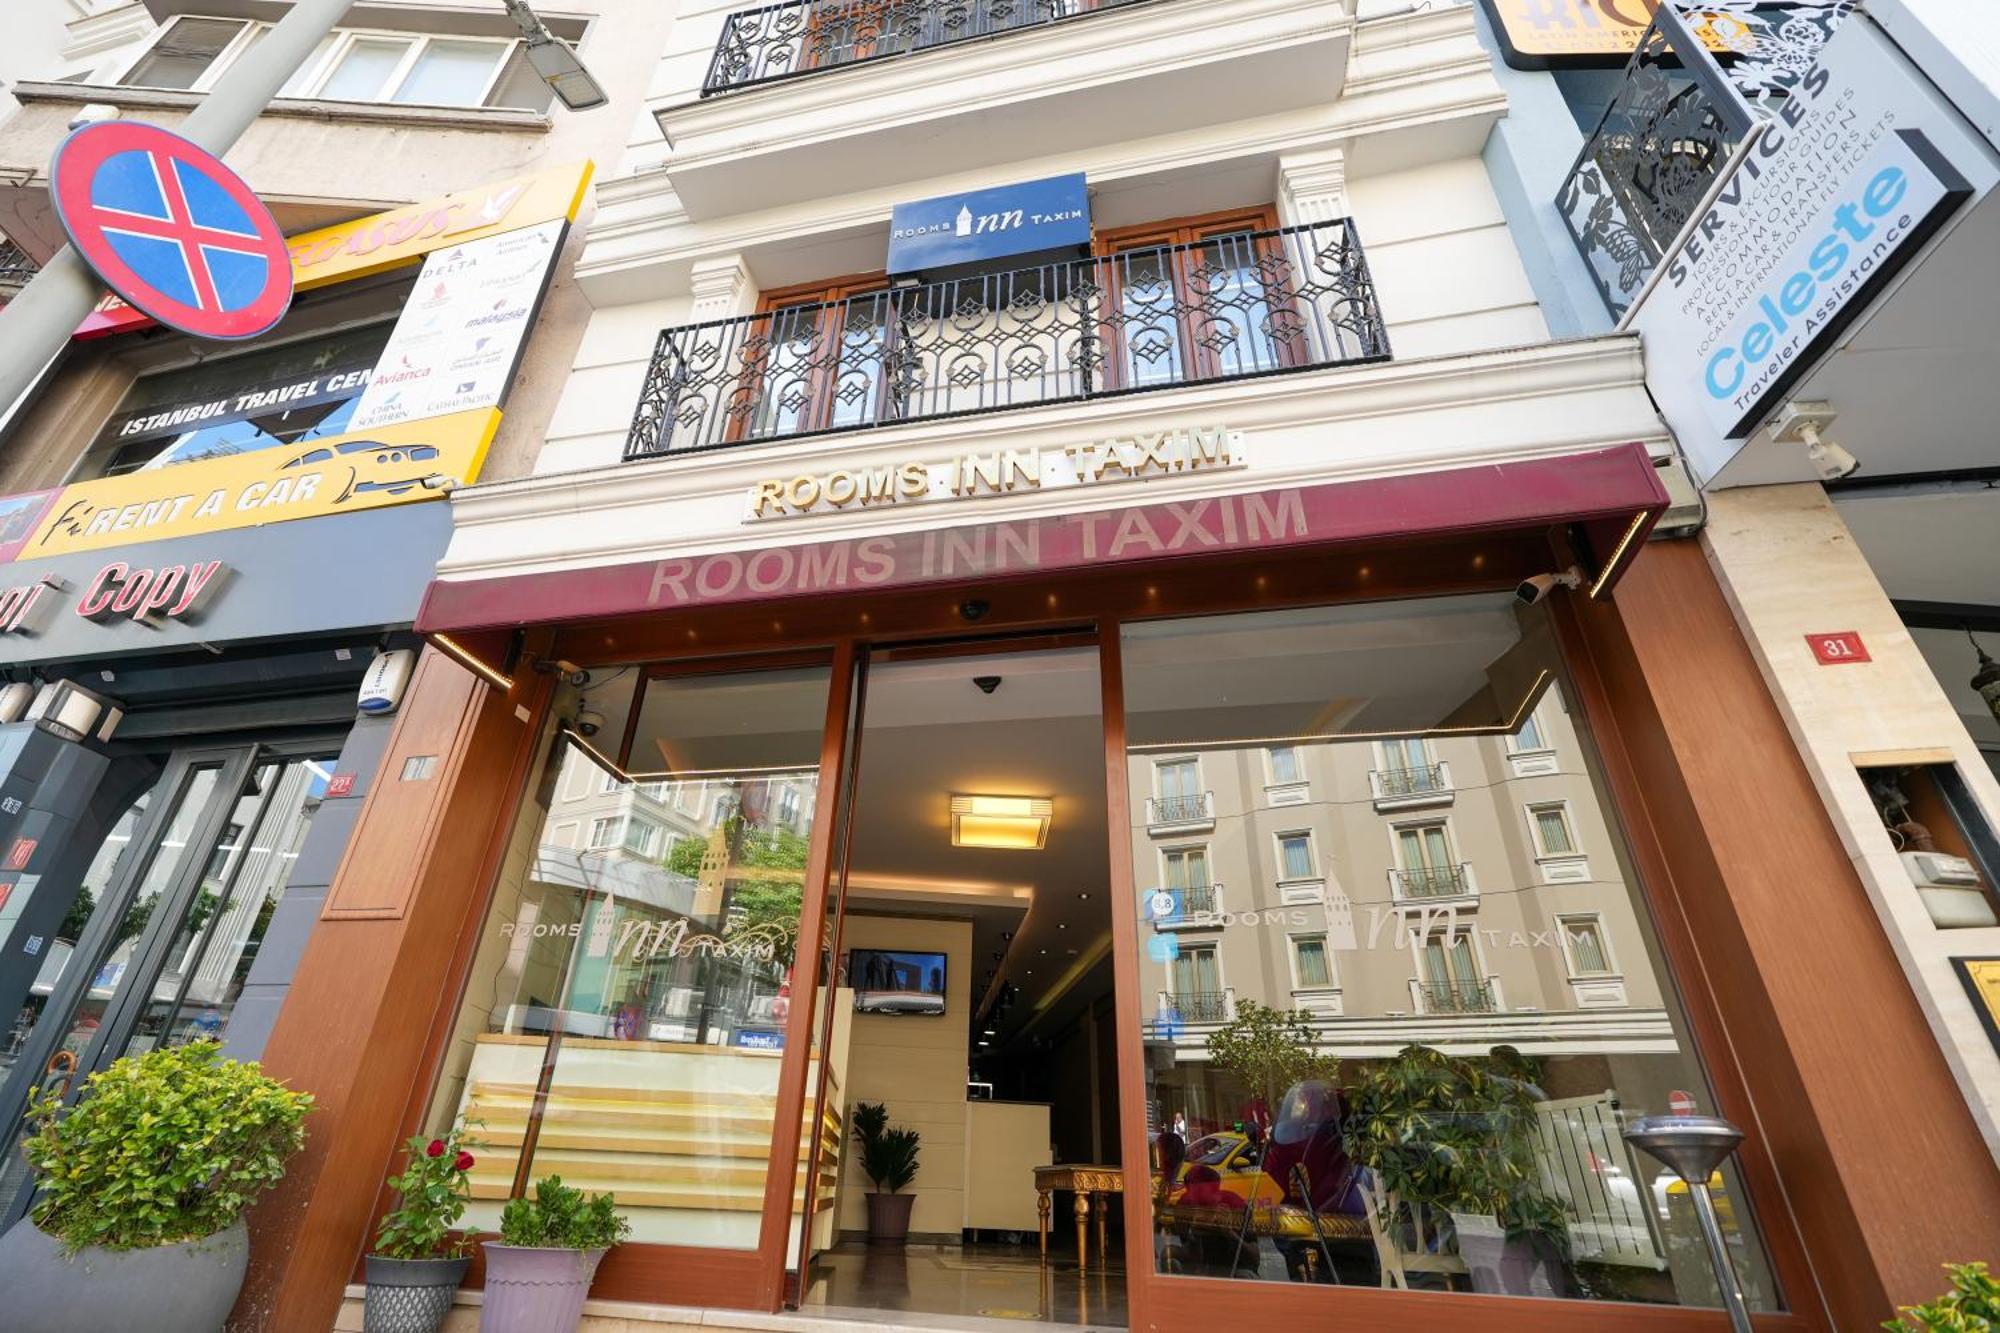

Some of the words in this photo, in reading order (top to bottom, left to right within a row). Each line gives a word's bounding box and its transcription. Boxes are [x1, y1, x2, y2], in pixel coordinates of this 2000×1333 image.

[1668, 62, 1830, 288] SERVICES
[1681, 210, 1763, 315] PROFESSIONAL
[1763, 161, 1799, 206] TOUR
[1799, 87, 1855, 158] GUIDES
[1692, 233, 1728, 280] TOURS
[1729, 221, 1739, 233] &
[1739, 110, 1821, 218] EXCURSIONS
[1696, 109, 1856, 319] ACCOMMODATION
[1705, 289, 1733, 327] RENT
[1735, 278, 1744, 290] A
[1745, 244, 1770, 275] CAR
[1772, 229, 1782, 243] &
[1782, 130, 1860, 226] TRANSFERS
[422, 257, 477, 279] DELTA
[1697, 320, 1727, 357] LOCAL
[1733, 205, 1821, 309] INTERNATIONAL
[1820, 177, 1840, 202] FLY
[1840, 109, 1896, 175] TICKETS
[1705, 166, 1907, 399] Celeste
[1733, 335, 1800, 411] Traveler
[1805, 213, 1912, 335] Assistance
[119, 401, 228, 437] ISTANBUL
[235, 381, 317, 412] TRAVEL
[84, 494, 195, 536] RENT
[192, 488, 227, 519] A
[235, 472, 322, 512] CAR
[753, 461, 931, 517] ROOMS
[950, 447, 1042, 496] INN
[1064, 424, 1231, 481] TAXIM
[76, 560, 222, 621] Copy
[648, 536, 898, 604] ROOMS
[921, 519, 1040, 577] INN
[1066, 490, 1310, 559] TAXIM
[1823, 638, 1852, 656] 31
[499, 922, 582, 938] ROOMS
[699, 941, 775, 959] TAXIM
[1194, 911, 1308, 927] ROOMS
[1481, 929, 1593, 947] TAXIM
